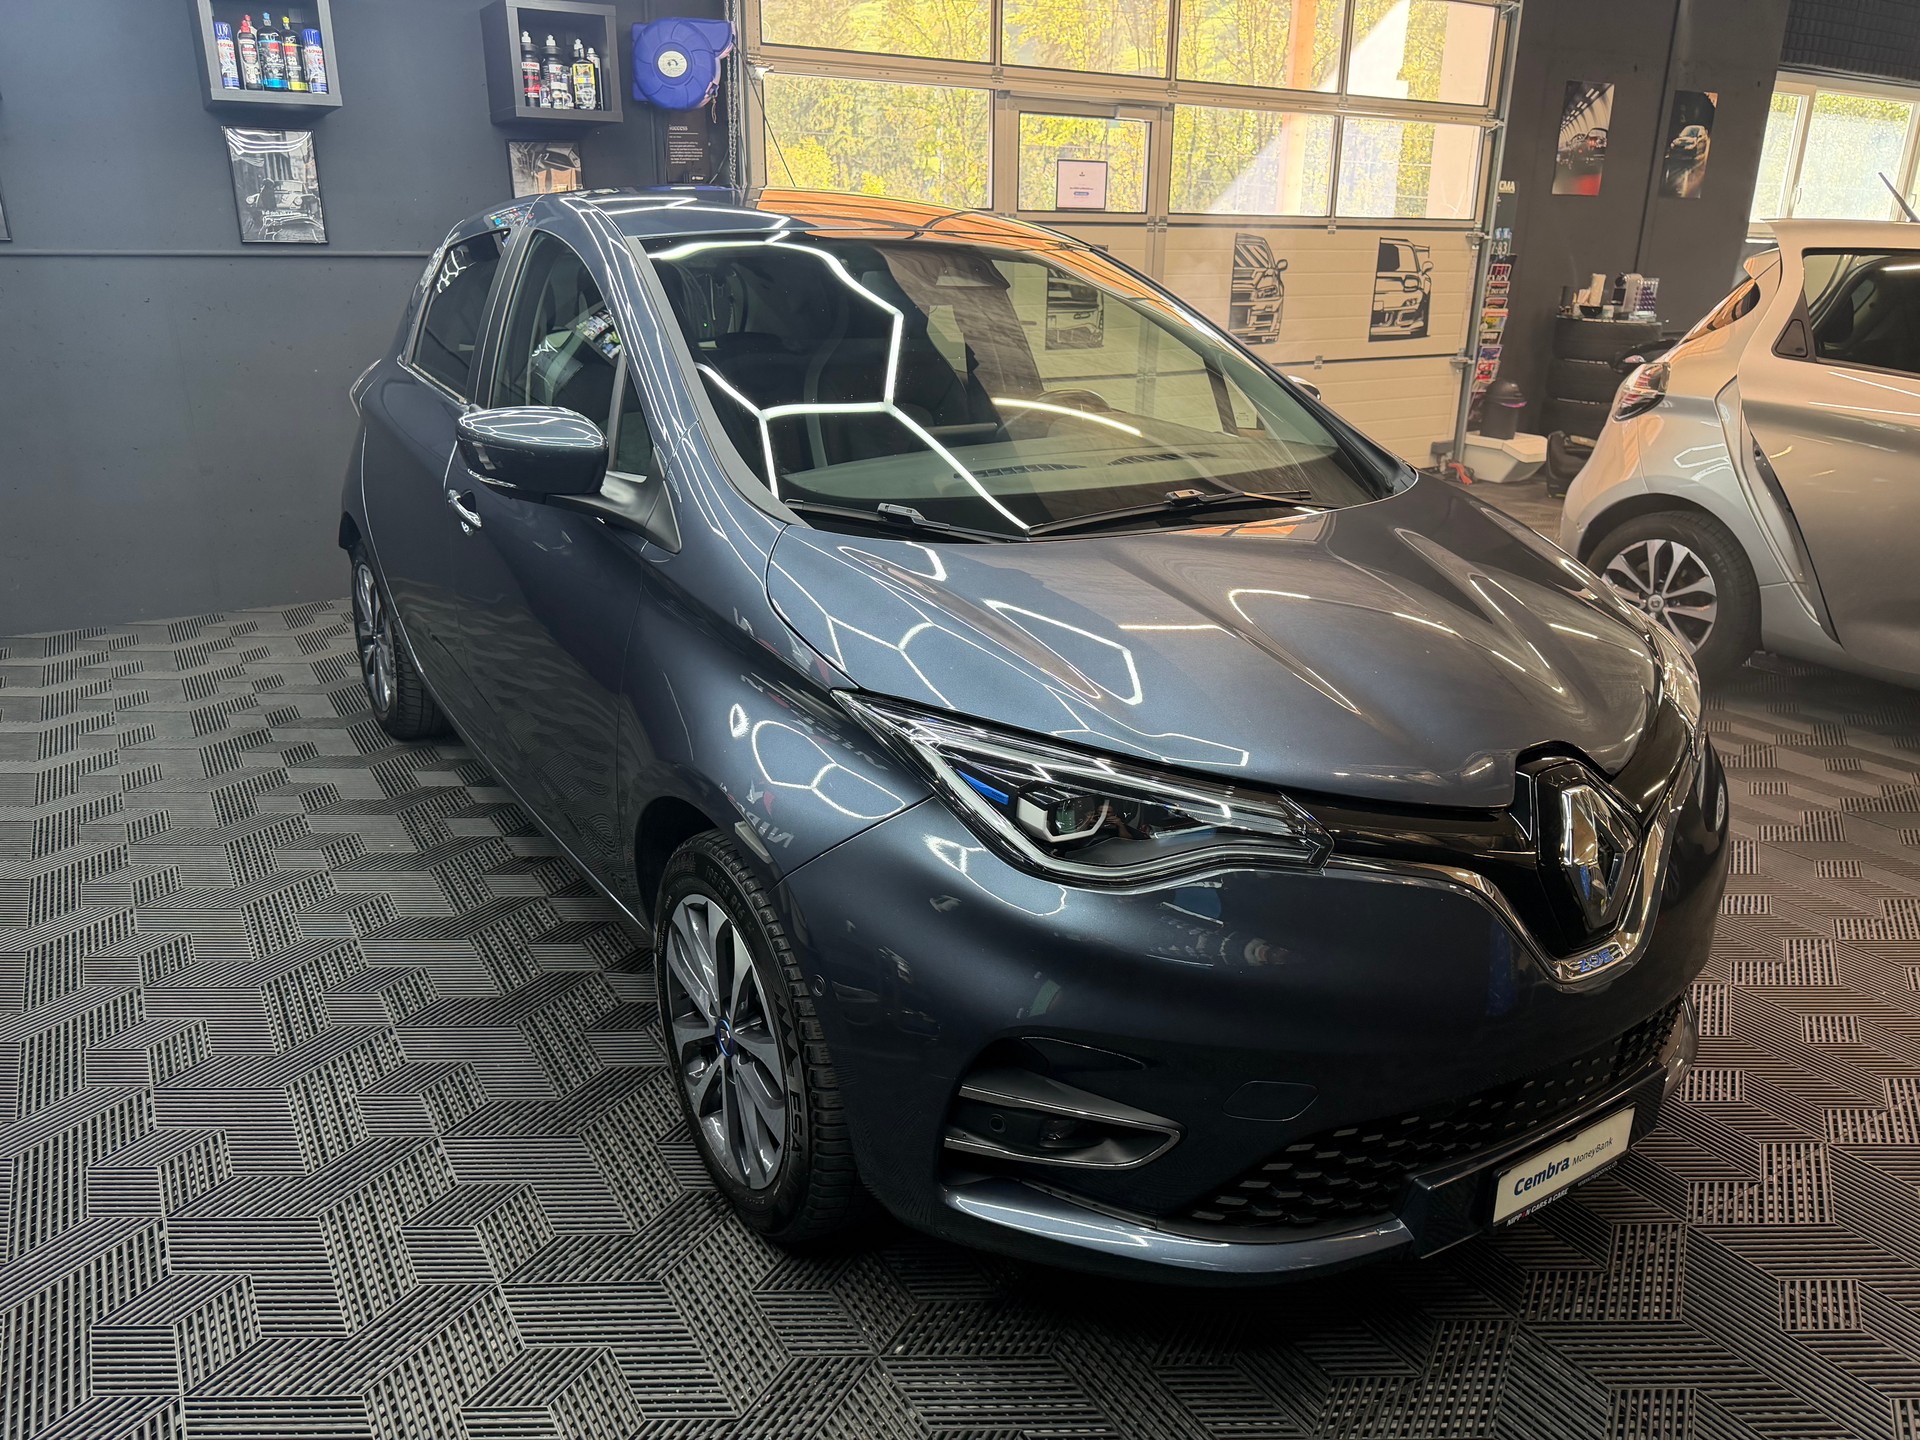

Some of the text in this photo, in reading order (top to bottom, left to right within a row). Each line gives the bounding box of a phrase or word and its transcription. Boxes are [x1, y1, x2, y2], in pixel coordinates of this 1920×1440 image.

[1580, 948, 1614, 972] ZOE
[1513, 1136, 1613, 1196] Cembra MoneyBank
[1506, 1208, 1531, 1227] NIPPON
[1531, 1199, 1547, 1214] CARS
[1552, 1187, 1570, 1203] CARE
